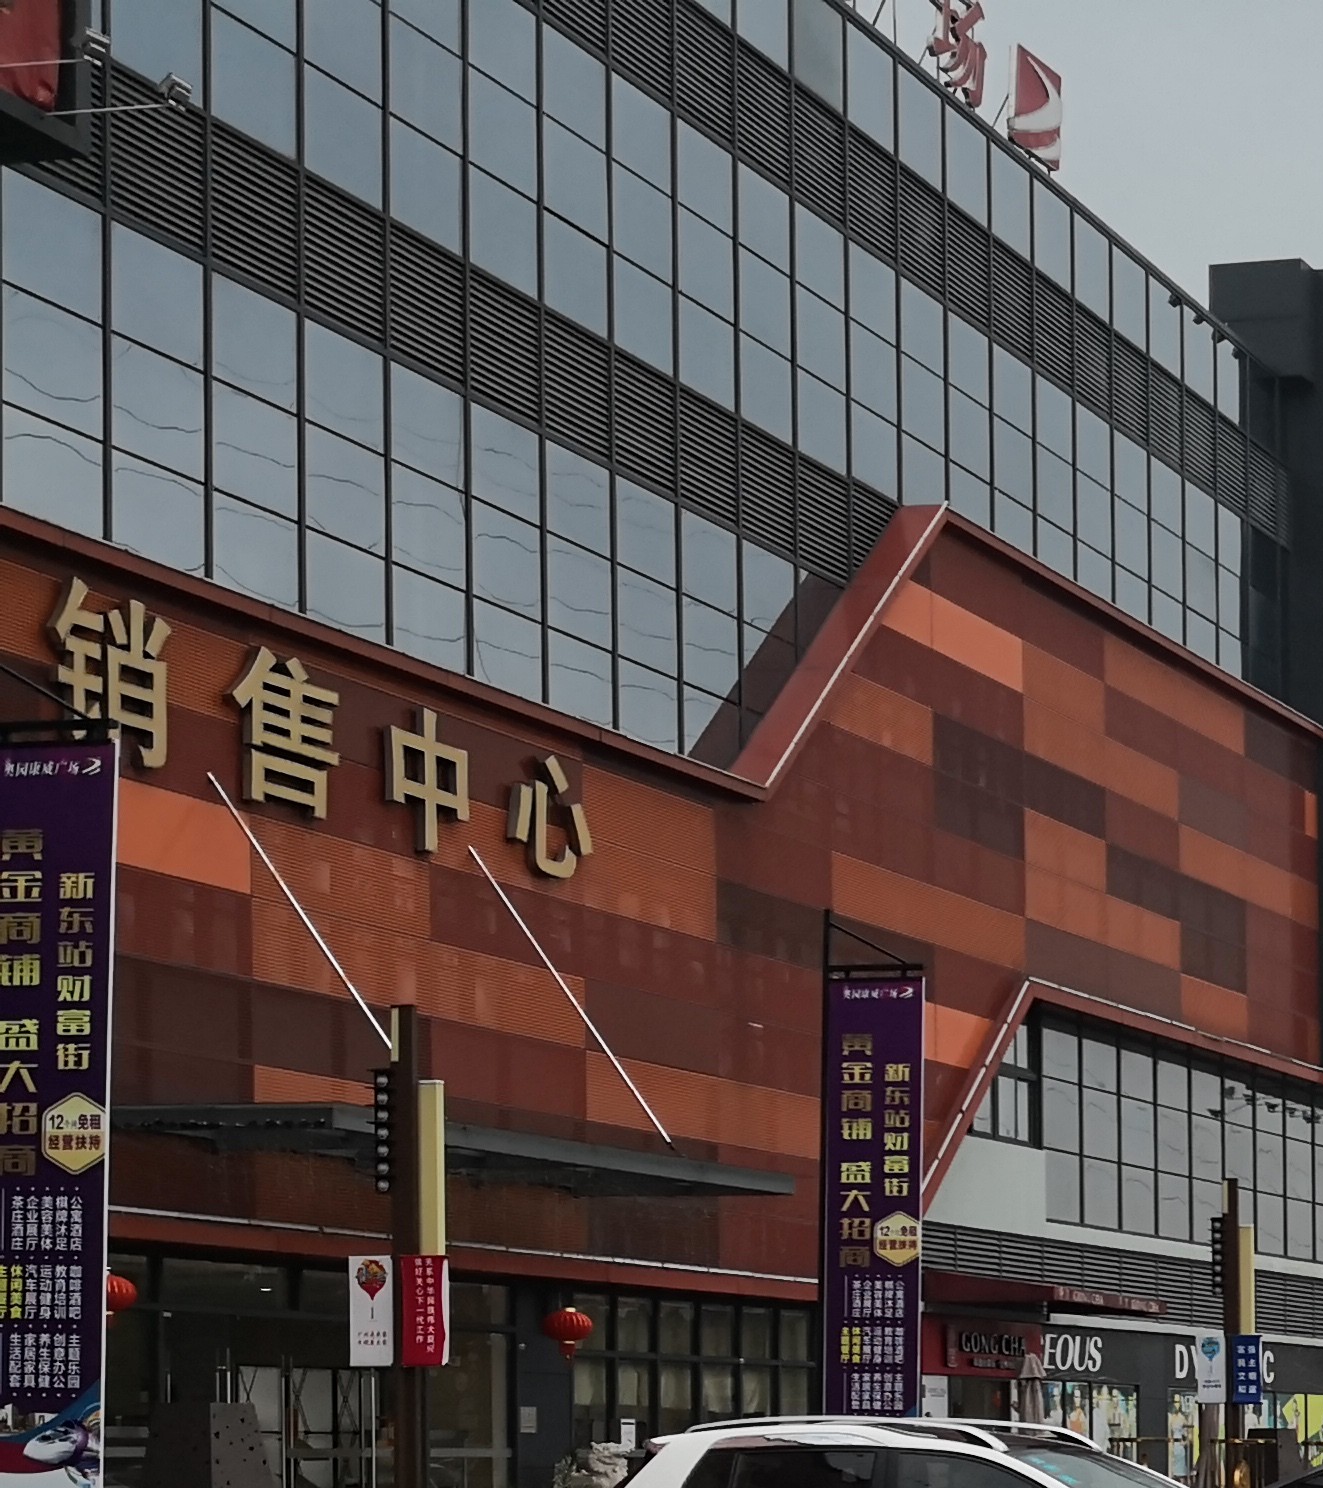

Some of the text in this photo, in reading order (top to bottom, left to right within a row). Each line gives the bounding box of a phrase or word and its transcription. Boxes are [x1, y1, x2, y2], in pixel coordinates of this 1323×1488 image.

[47, 576, 593, 880] 销售中心
[56, 872, 95, 1070] 新东站财富街
[48, 1134, 100, 1151] 经营扶持
[884, 1063, 911, 1197] 新东站财富街
[962, 1331, 999, 1355] GONG
[1001, 1334, 1027, 1357] CHA
